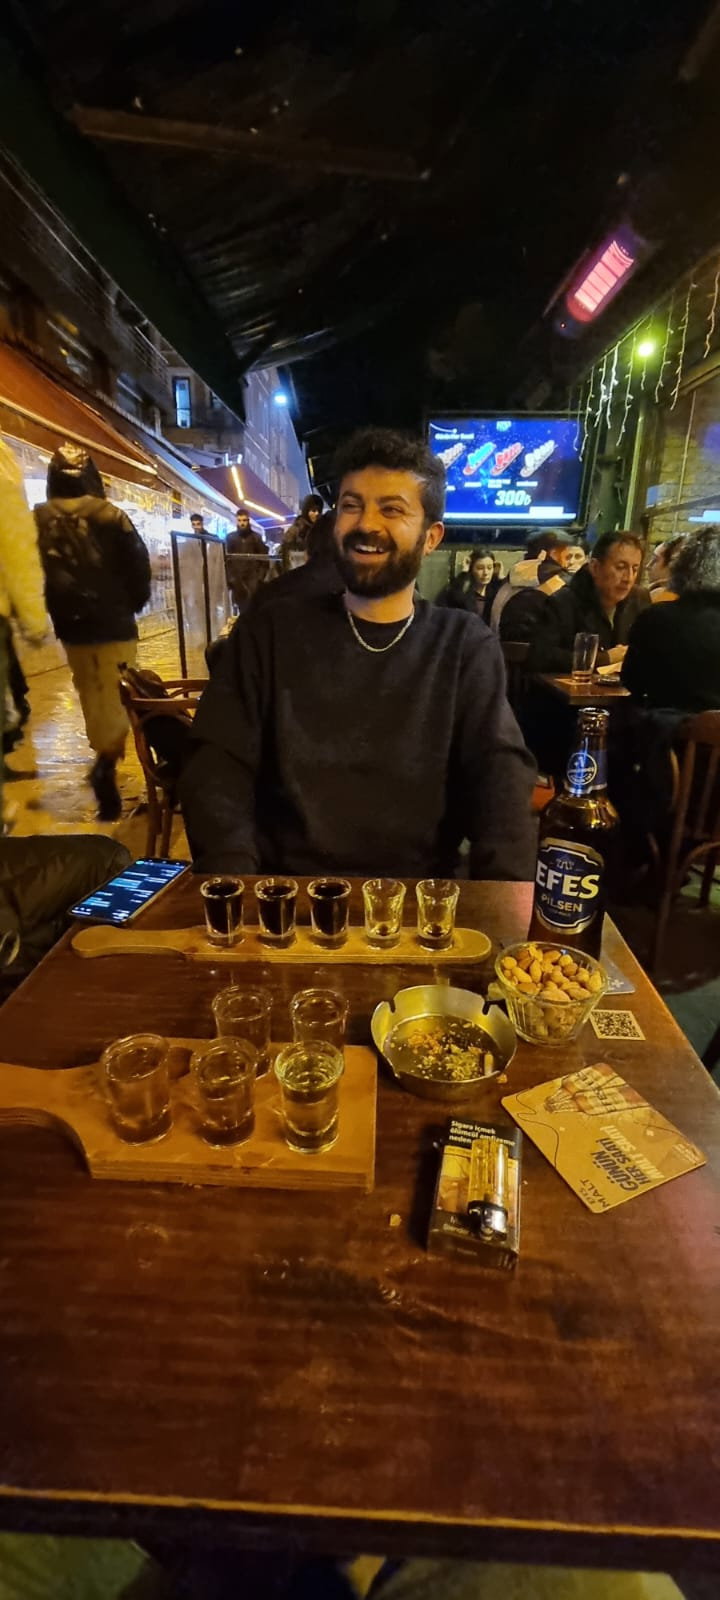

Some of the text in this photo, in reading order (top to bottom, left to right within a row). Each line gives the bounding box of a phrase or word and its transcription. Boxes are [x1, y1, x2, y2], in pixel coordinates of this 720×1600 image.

[535, 859, 600, 900] EFES
[541, 893, 583, 912] PILSEN
[590, 1151, 639, 1191] GÜNÜN
[625, 1165, 652, 1185] HER
[628, 1153, 665, 1179] MALT
[580, 1179, 611, 1208] MALT
